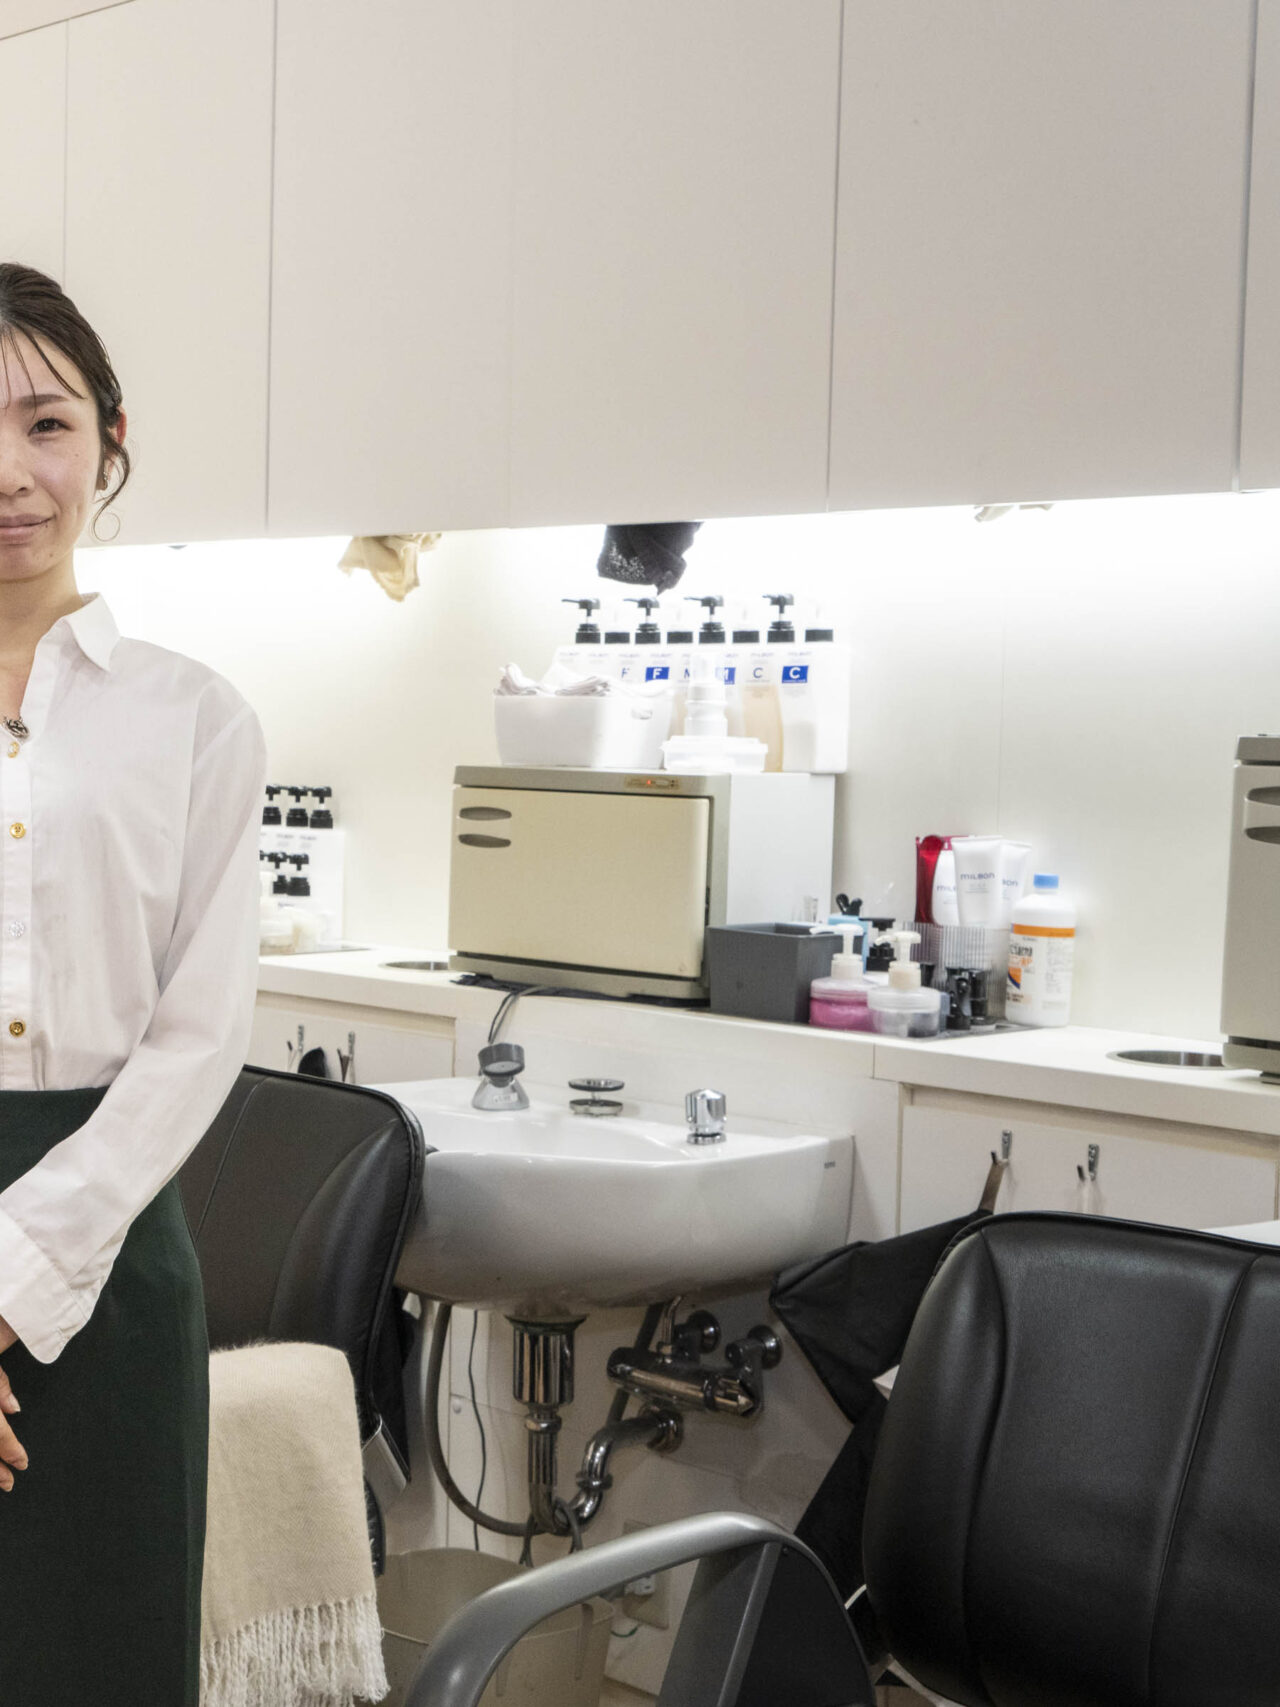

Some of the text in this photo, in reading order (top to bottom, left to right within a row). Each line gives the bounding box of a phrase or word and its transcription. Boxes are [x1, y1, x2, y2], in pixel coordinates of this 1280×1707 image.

[652, 667, 663, 680] F
[753, 667, 764, 680] C
[789, 666, 801, 680] C
